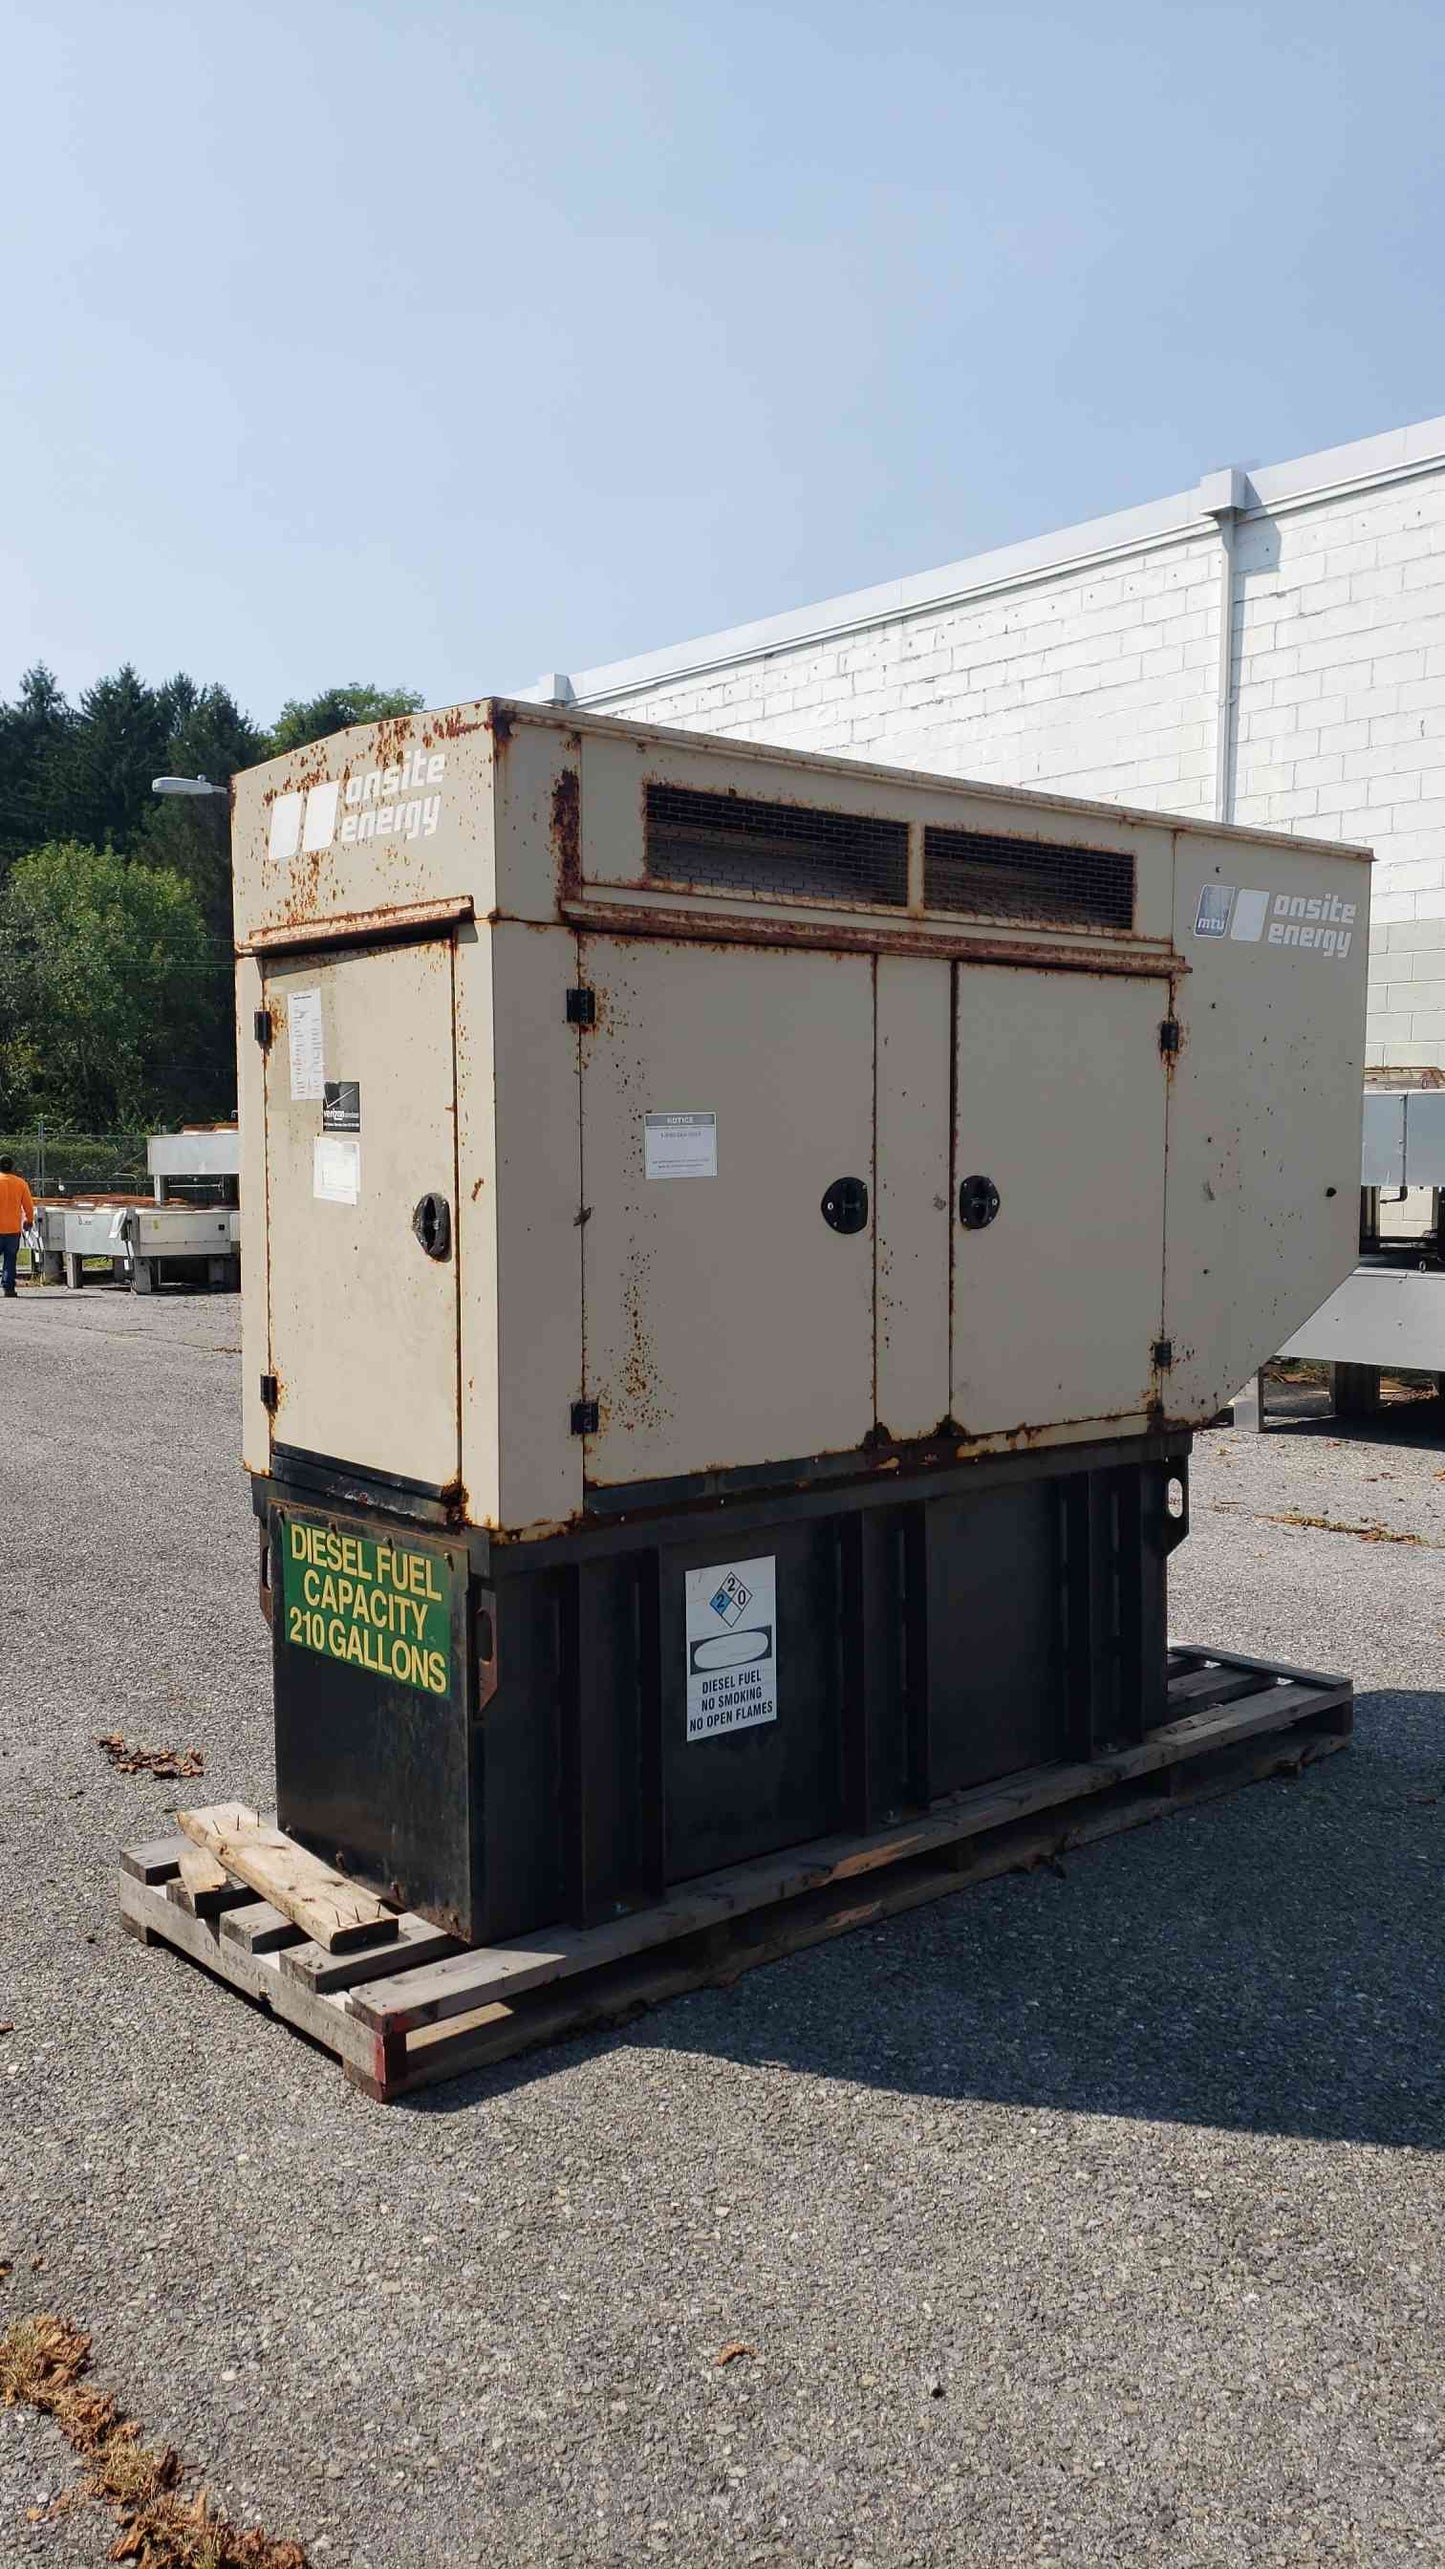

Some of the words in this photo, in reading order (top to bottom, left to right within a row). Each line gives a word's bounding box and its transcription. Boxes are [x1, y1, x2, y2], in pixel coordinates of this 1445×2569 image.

[345, 749, 446, 804] onsite
[341, 795, 442, 842] energy
[1197, 915, 1225, 931] mtu
[1273, 892, 1357, 925] onsite
[1267, 922, 1352, 959] energy
[290, 1523, 373, 1581] DIESEL
[376, 1546, 443, 1602] FUEL
[716, 1593, 726, 1609] 2
[737, 1589, 747, 1605] 0
[727, 1577, 736, 1592] 2
[303, 1568, 429, 1641] CAPACITY
[289, 1606, 326, 1651] 210
[328, 1617, 447, 1694] GALLONS
[702, 1675, 736, 1695] DIESEL
[738, 1669, 762, 1686] FUEL
[701, 1698, 715, 1712] NO
[718, 1686, 762, 1709] SMOKING
[689, 1717, 704, 1733] NO
[706, 1709, 733, 1728] OPEN
[735, 1700, 774, 1722] FLAMES
